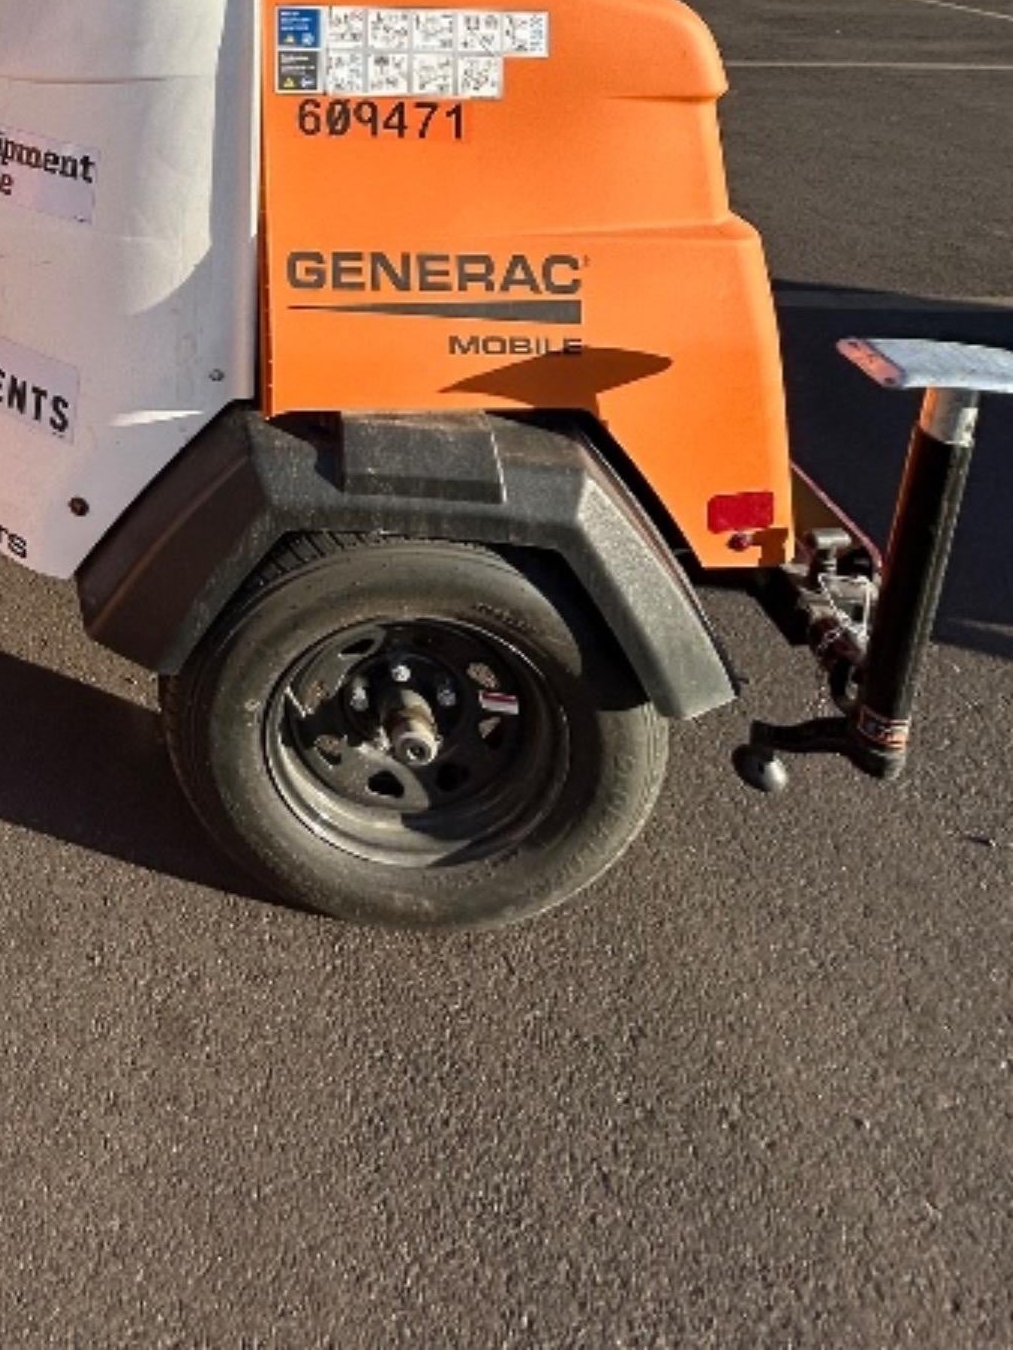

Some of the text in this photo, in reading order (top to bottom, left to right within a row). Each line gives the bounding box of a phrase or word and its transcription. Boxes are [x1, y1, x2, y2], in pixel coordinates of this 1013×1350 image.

[298, 98, 464, 139] 609471
[287, 251, 582, 295] GENERAC
[448, 335, 582, 356] MOBILE
